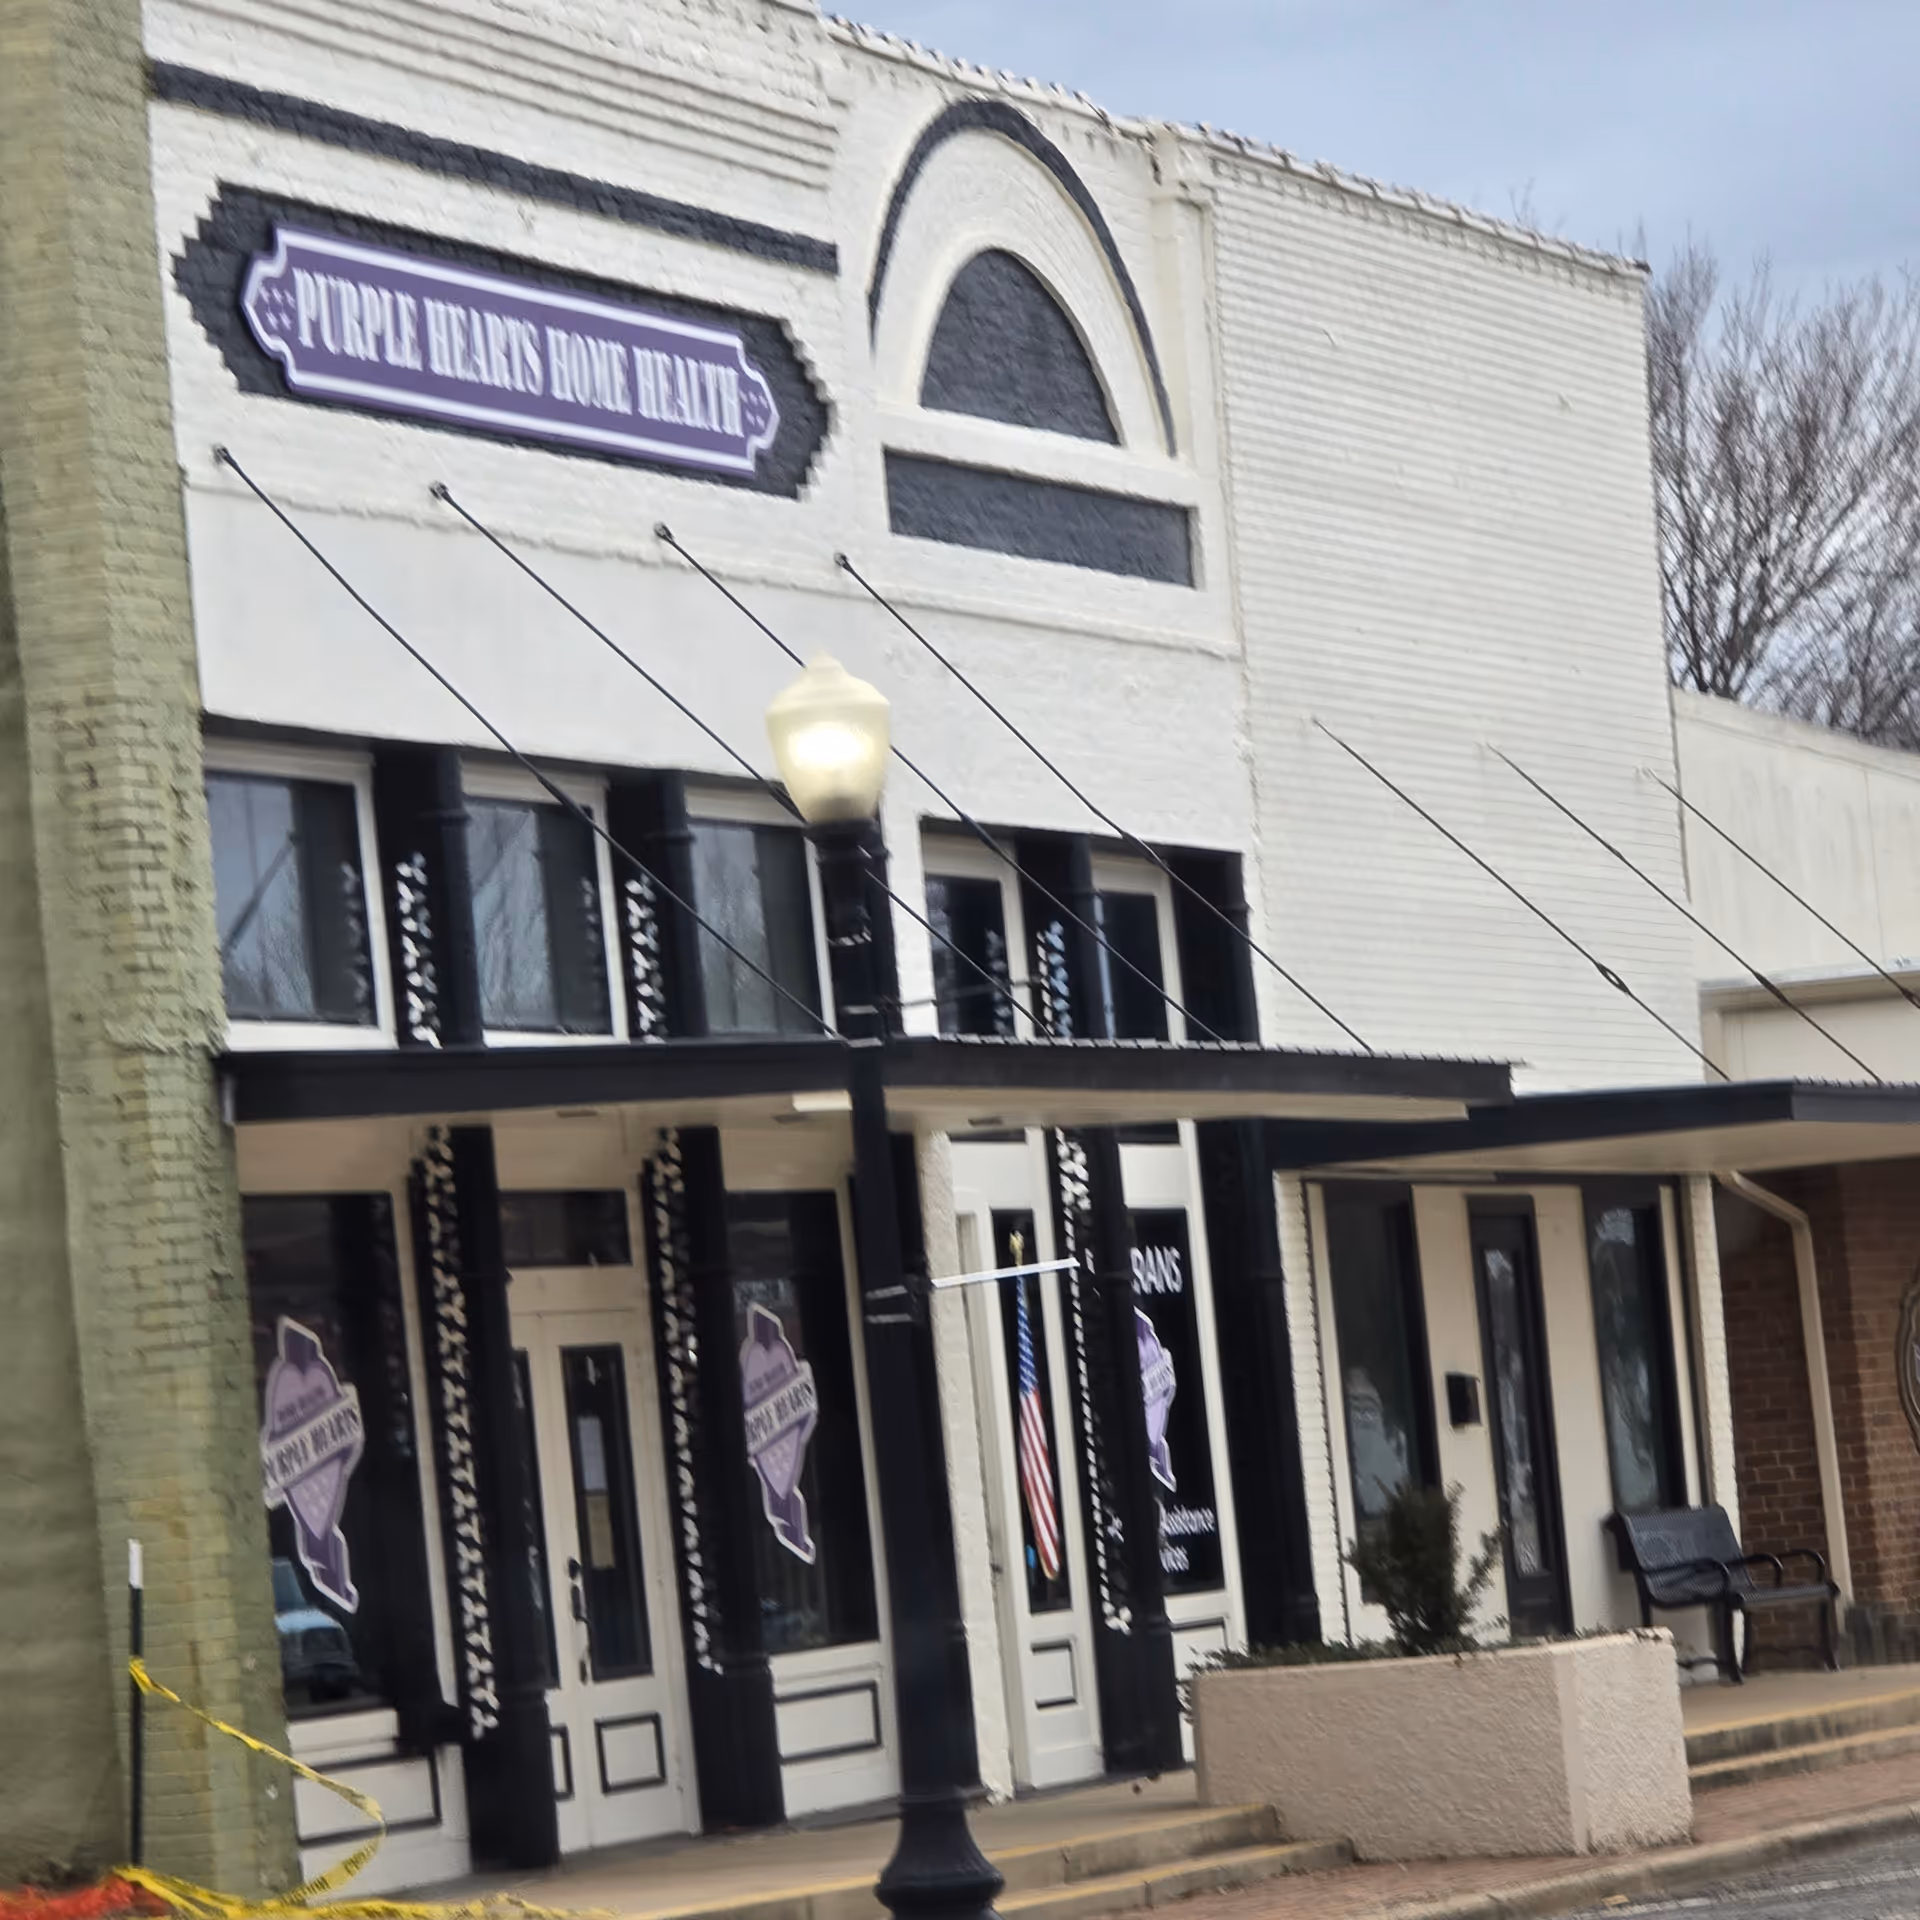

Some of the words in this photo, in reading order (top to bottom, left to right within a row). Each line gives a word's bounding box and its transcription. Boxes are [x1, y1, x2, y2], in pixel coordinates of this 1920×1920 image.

[292, 267, 423, 372] PURPLE
[422, 297, 544, 397] HEARTS
[545, 325, 634, 415] HOME
[633, 347, 745, 438] HEALTH
